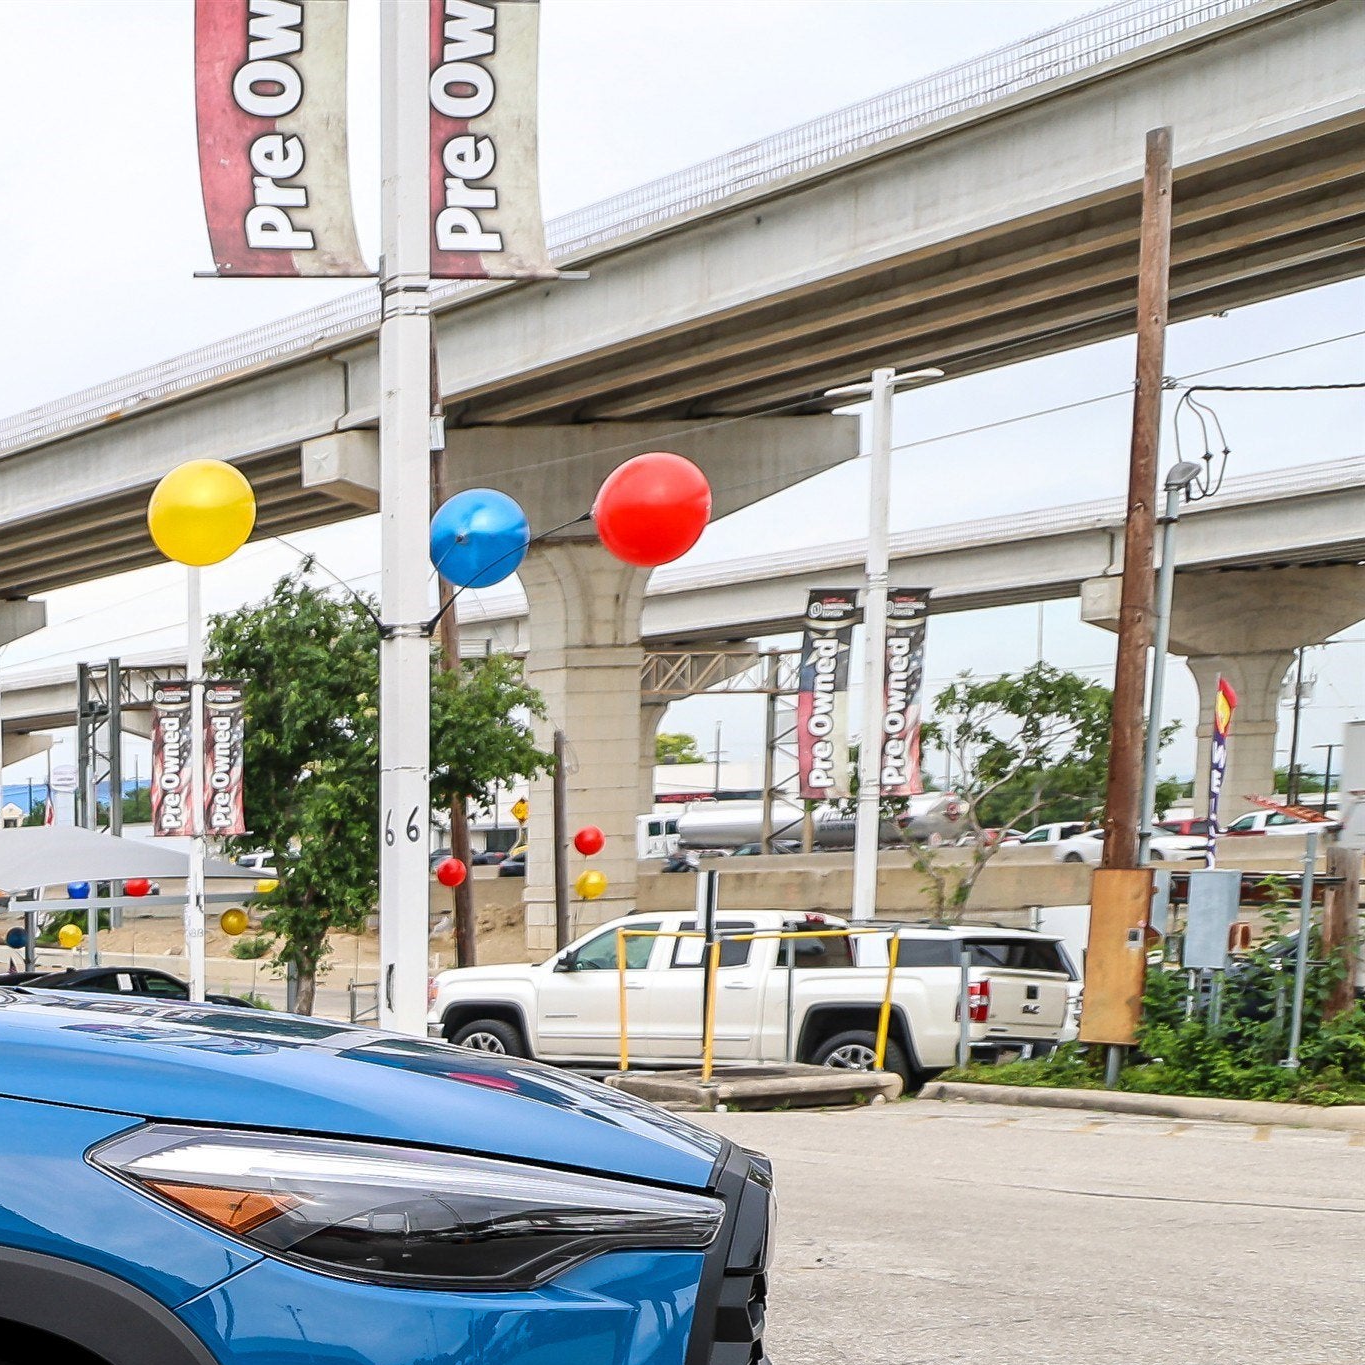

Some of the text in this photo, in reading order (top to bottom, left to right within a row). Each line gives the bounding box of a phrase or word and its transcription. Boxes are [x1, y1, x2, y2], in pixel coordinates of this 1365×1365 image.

[244, 133, 316, 250] Pre
[434, 133, 504, 251] Pre
[807, 637, 839, 737] Owned
[884, 636, 911, 734] Owned
[160, 716, 181, 790] Owned
[211, 716, 231, 790] Owned
[809, 739, 835, 788] Pre
[881, 738, 906, 786] Pre
[161, 791, 182, 829] Pre
[212, 791, 232, 828] Pre
